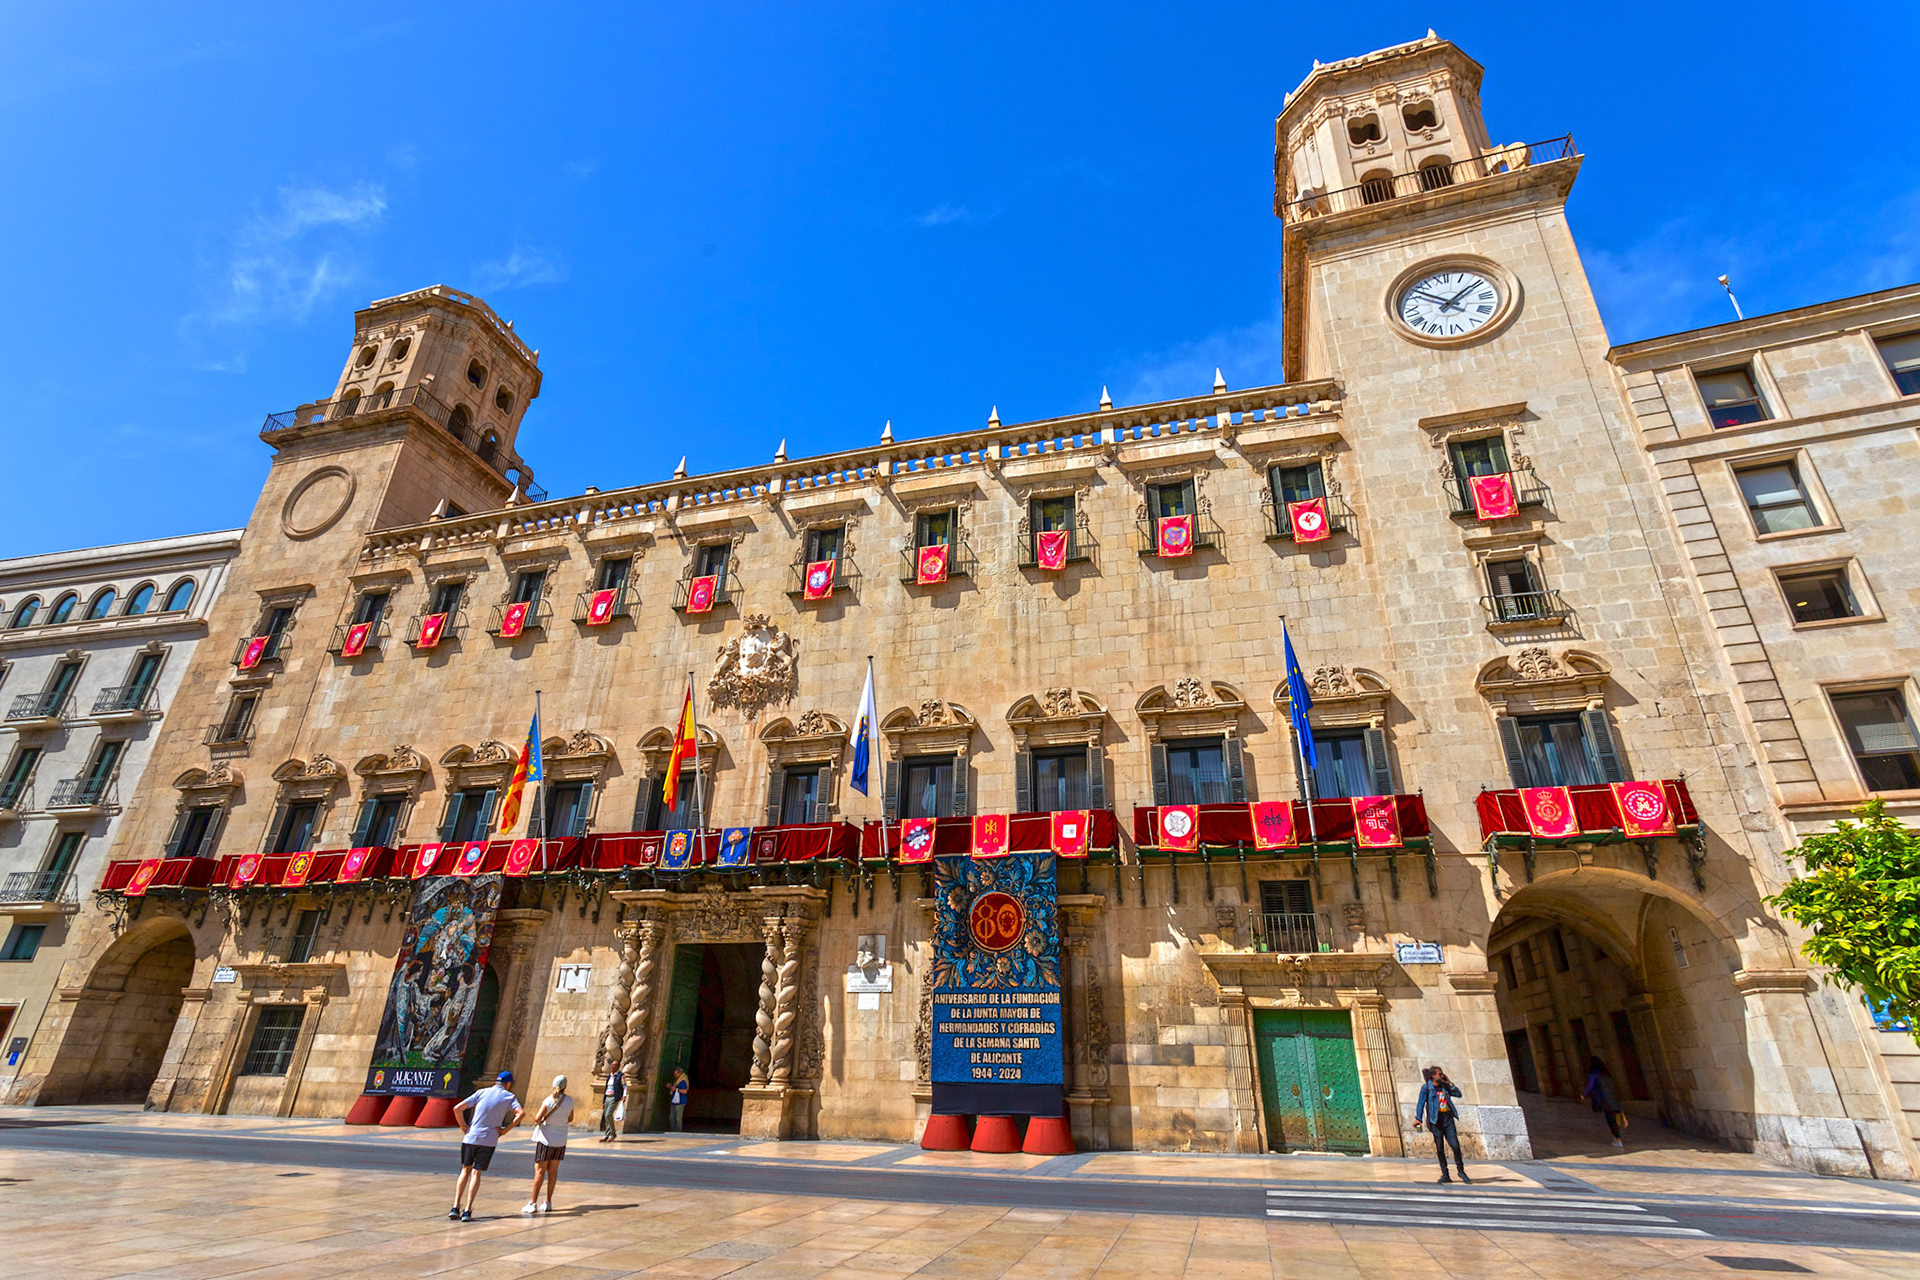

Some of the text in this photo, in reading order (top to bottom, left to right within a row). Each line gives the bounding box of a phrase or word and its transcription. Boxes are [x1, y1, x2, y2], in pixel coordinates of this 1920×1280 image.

[975, 899, 1018, 944] 80
[934, 992, 1060, 1004] ANIVERSARIO DE LA FUNDACIÓN
[950, 1008, 1041, 1019] DE LA JUNTA MAYOR DE
[939, 1021, 1056, 1033] HERMANDADES Y COFRADÍAS
[954, 1037, 1040, 1048] DE LA SEMANA SANTA
[970, 1052, 1022, 1063] DE ALICANTE
[393, 1071, 436, 1082] ALICANTE
[972, 1068, 992, 1078] 1944
[999, 1068, 1022, 1079] 2024
